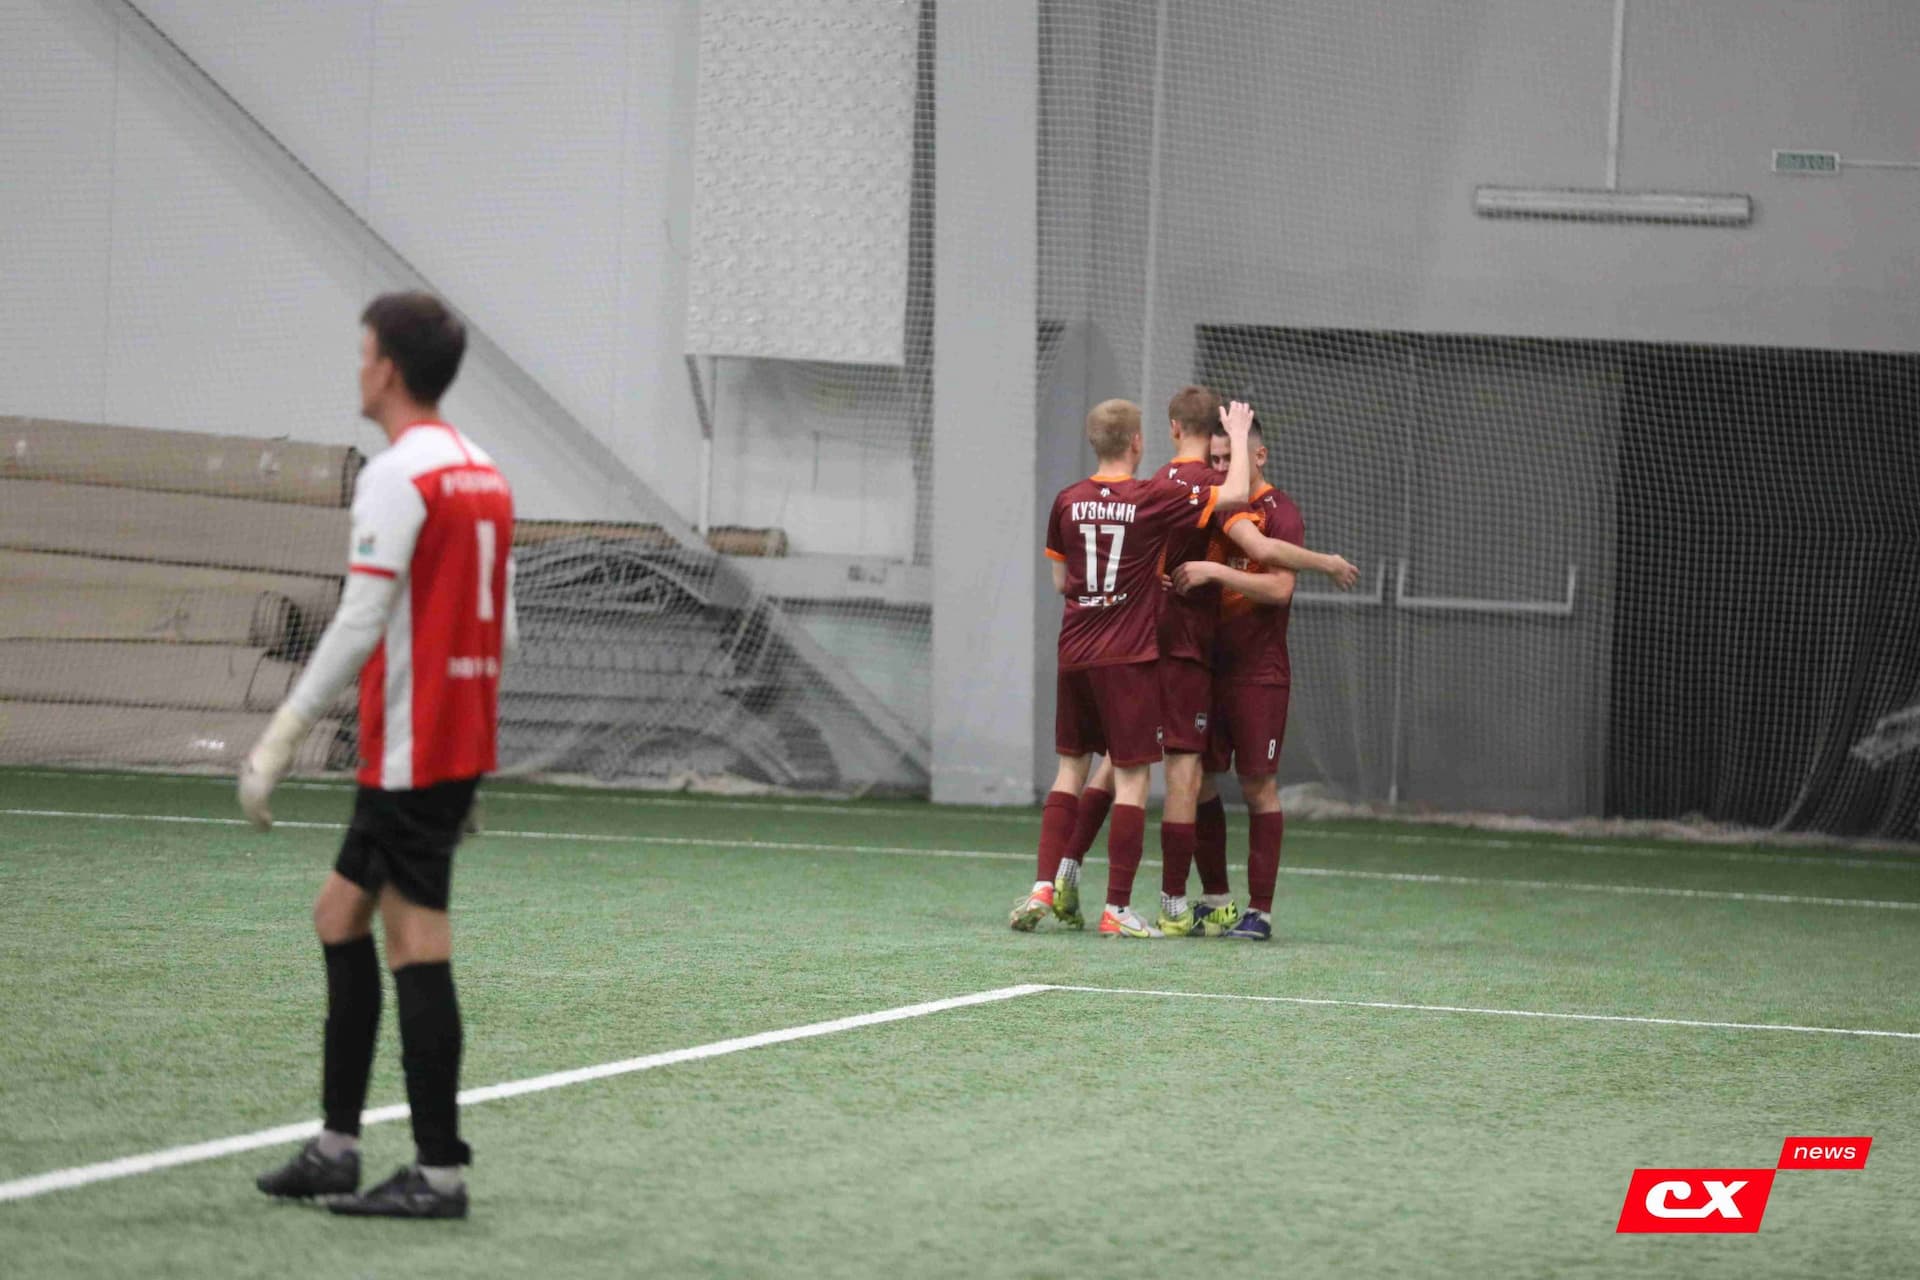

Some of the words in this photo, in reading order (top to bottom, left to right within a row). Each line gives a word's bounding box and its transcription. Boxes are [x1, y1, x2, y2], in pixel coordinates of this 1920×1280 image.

[1071, 501, 1136, 523] КУЗЬКИН
[476, 519, 497, 621] 1
[1079, 524, 1125, 592] 17
[1267, 738, 1277, 760] 8
